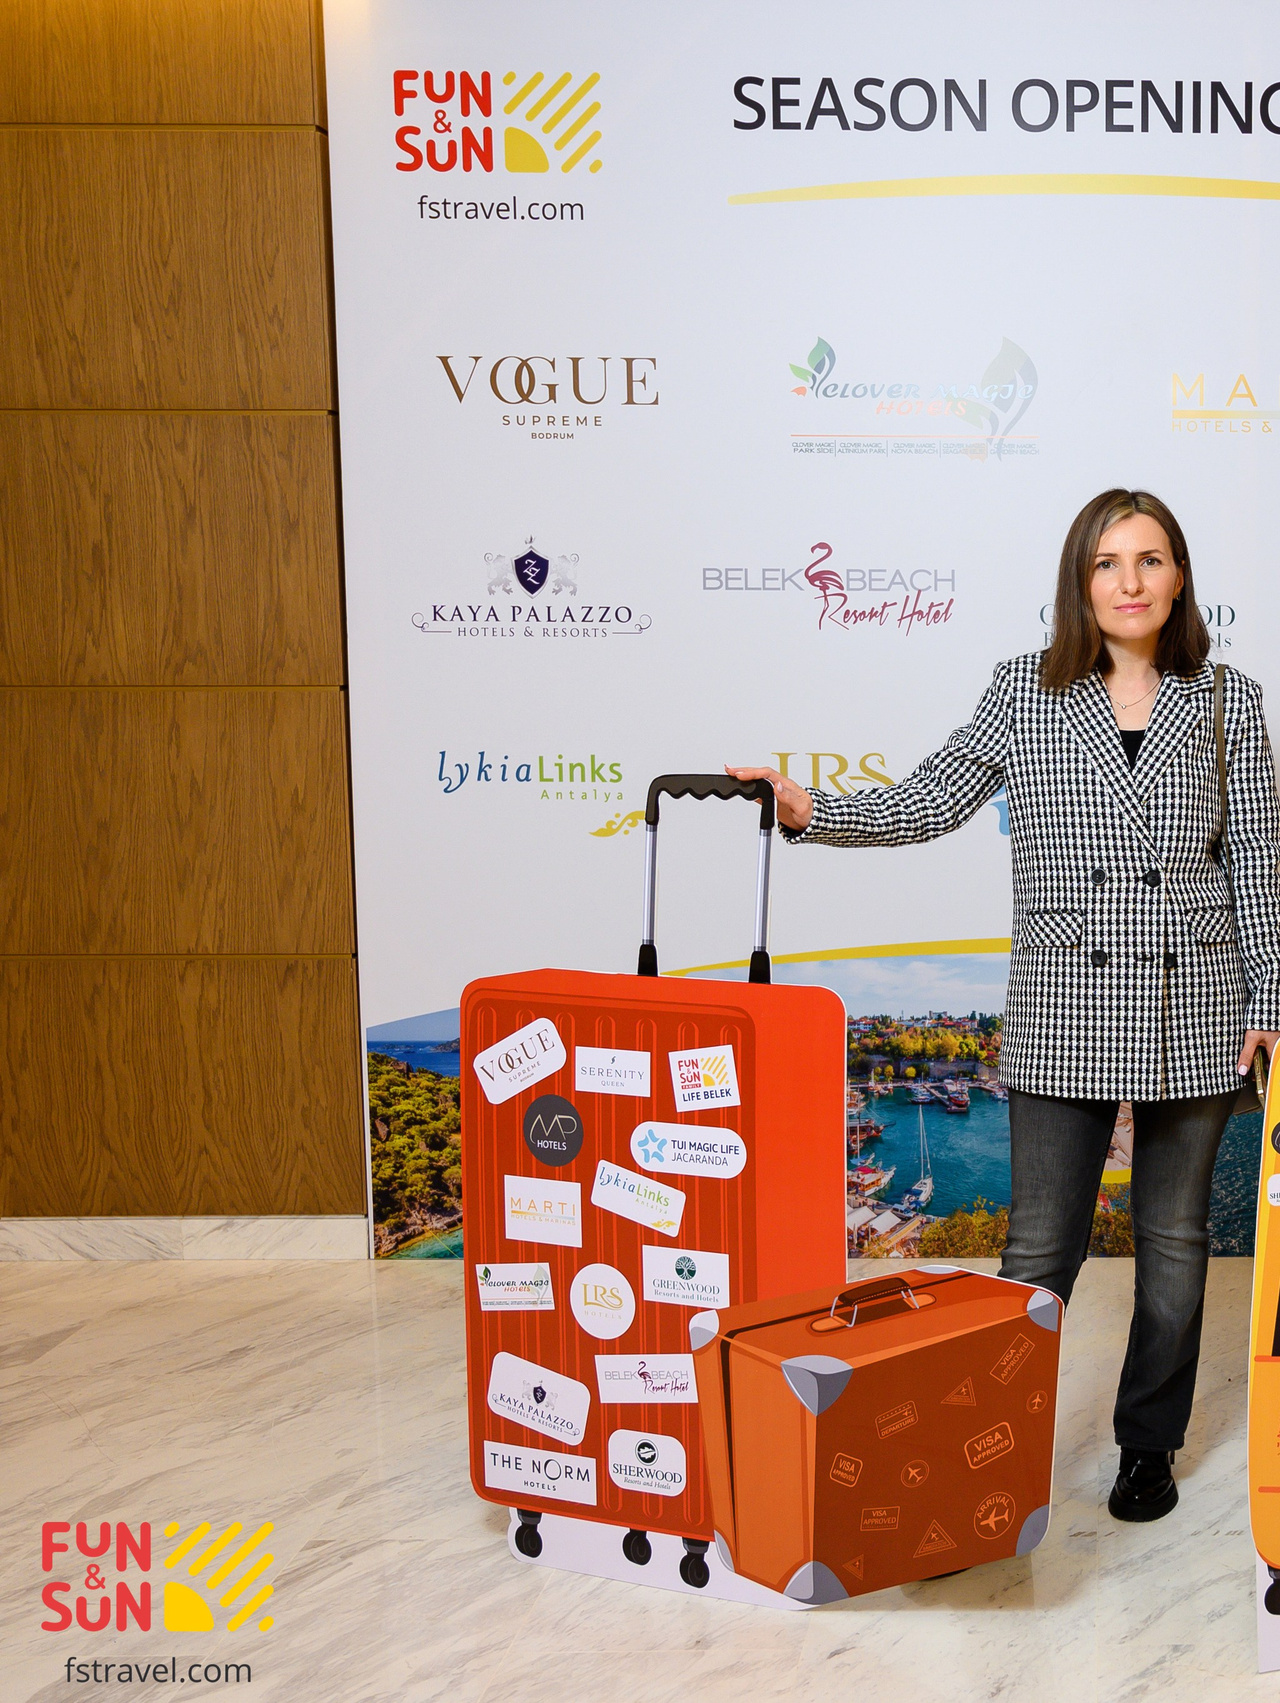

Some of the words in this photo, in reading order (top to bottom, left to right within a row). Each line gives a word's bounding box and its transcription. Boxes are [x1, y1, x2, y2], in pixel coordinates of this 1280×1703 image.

[394, 70, 492, 118] FUN
[732, 76, 988, 133] SEASON
[433, 109, 453, 134] &
[395, 125, 493, 173] SUN
[417, 195, 584, 221] fstravel.com
[436, 356, 659, 405] VOGUE
[821, 383, 920, 399] CLOVER
[930, 383, 1034, 401] MAGIC
[502, 415, 603, 427] SUPREME
[1172, 420, 1251, 433] HOTELS
[1261, 421, 1273, 433] &
[531, 432, 575, 440] BODRUM
[702, 568, 805, 592] BELEK
[846, 569, 956, 592] BEACH
[432, 605, 501, 622] KAYA
[511, 605, 632, 623] PALAZZO
[814, 592, 898, 632] Resort
[897, 589, 955, 637] Hotel
[457, 627, 515, 637] HOTELS
[523, 626, 534, 637] &
[542, 627, 608, 638] RESORTS
[540, 789, 623, 802] Antalya
[480, 1028, 555, 1082] VOGUE
[508, 1061, 541, 1083] SUPREME
[580, 1066, 645, 1080] SERENITY
[678, 1058, 699, 1072] FUN
[600, 1080, 625, 1088] QUEEN
[680, 1071, 701, 1084] SUN
[682, 1091, 701, 1102] LIFE
[703, 1088, 732, 1100] BELEK
[529, 1113, 578, 1144] MP
[537, 1139, 567, 1151] HOTELS
[671, 1139, 686, 1150] TUI
[689, 1141, 718, 1153] MAGIC
[721, 1144, 740, 1155] LIFE
[671, 1152, 728, 1166] JACARANDA
[510, 1196, 576, 1217] MARTI
[635, 1198, 668, 1215] Antalya
[511, 1214, 536, 1222] HOTELS
[545, 1217, 576, 1226] MARINAS
[652, 1279, 720, 1295] GREENWOOD
[654, 1289, 679, 1298] Resorts
[697, 1294, 719, 1302] Hotels
[581, 1283, 624, 1310] LRS
[1000, 1348, 1016, 1366] VISA
[1000, 1341, 1030, 1380] APPROVED
[604, 1371, 638, 1380] BELEK
[651, 1370, 689, 1380] BEACH
[499, 1393, 524, 1410] KAYA
[528, 1405, 574, 1430] PALAZZO
[507, 1406, 529, 1419] HOTELS
[538, 1418, 563, 1433] RESORTS
[881, 1416, 915, 1437] DEPARTURE
[974, 1431, 1003, 1452] VISA
[972, 1439, 1010, 1464] APPROVED
[490, 1452, 522, 1471] THE
[532, 1459, 590, 1482] NORM
[612, 1463, 682, 1484] SHERWOOD
[839, 1458, 855, 1473] VISA
[623, 1477, 641, 1486] Resorts
[642, 1479, 653, 1487] and
[654, 1481, 671, 1490] Hotels
[832, 1469, 856, 1482] APPROVED
[523, 1480, 557, 1492] HOTELS
[976, 1495, 1010, 1519] ARRIVAL
[863, 1517, 897, 1525] APPROVED
